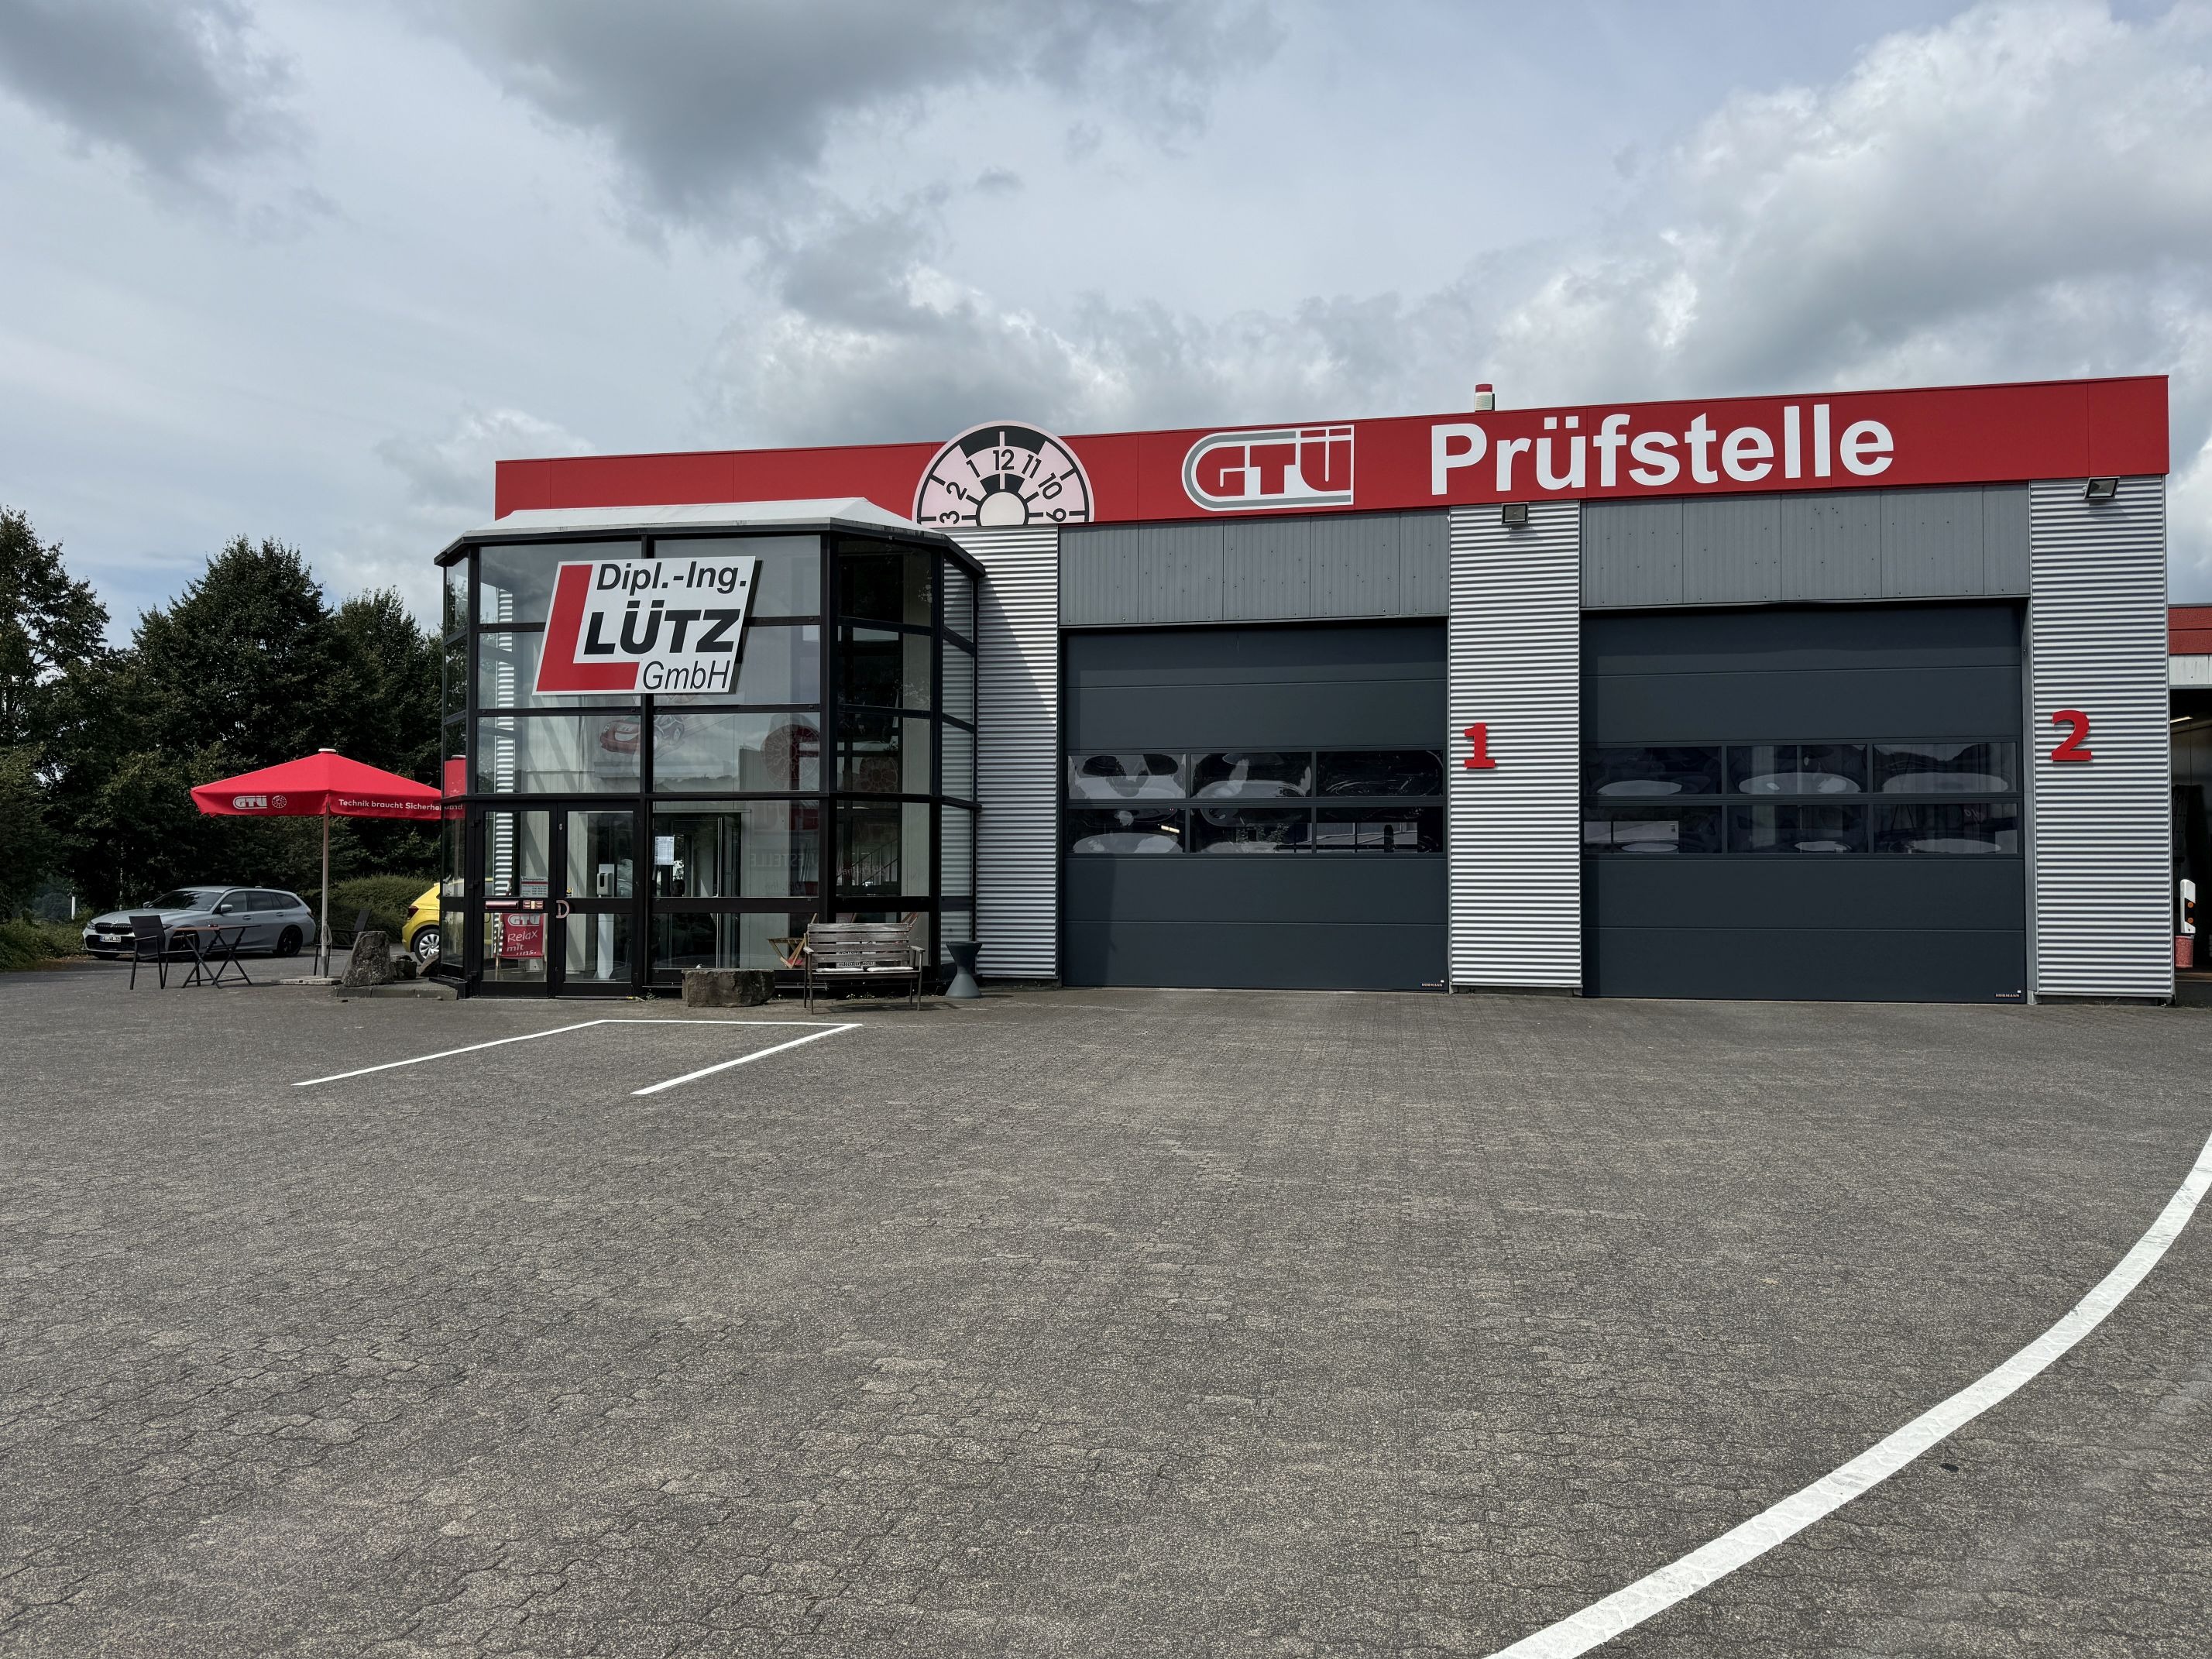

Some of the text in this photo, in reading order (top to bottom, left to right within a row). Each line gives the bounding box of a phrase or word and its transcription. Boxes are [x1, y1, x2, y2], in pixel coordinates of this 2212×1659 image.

[993, 449, 1014, 471] 12
[1431, 404, 1894, 496] Prüfstelle
[966, 459, 981, 479] 1
[1022, 454, 1042, 479] 11
[1182, 424, 1354, 511] GTÜ
[946, 482, 967, 500] 2
[1038, 472, 1063, 500] 10
[939, 510, 960, 524] 3
[596, 562, 747, 596] Dipl.-Ing.
[584, 599, 740, 654] LÜTZ
[643, 661, 730, 690] GmbH
[1464, 723, 1496, 768] 1
[2051, 710, 2092, 761] 2
[338, 799, 369, 807] Technik
[405, 802, 441, 811] Sicherhei
[507, 943, 524, 952] mit
[508, 929, 538, 943] Relax
